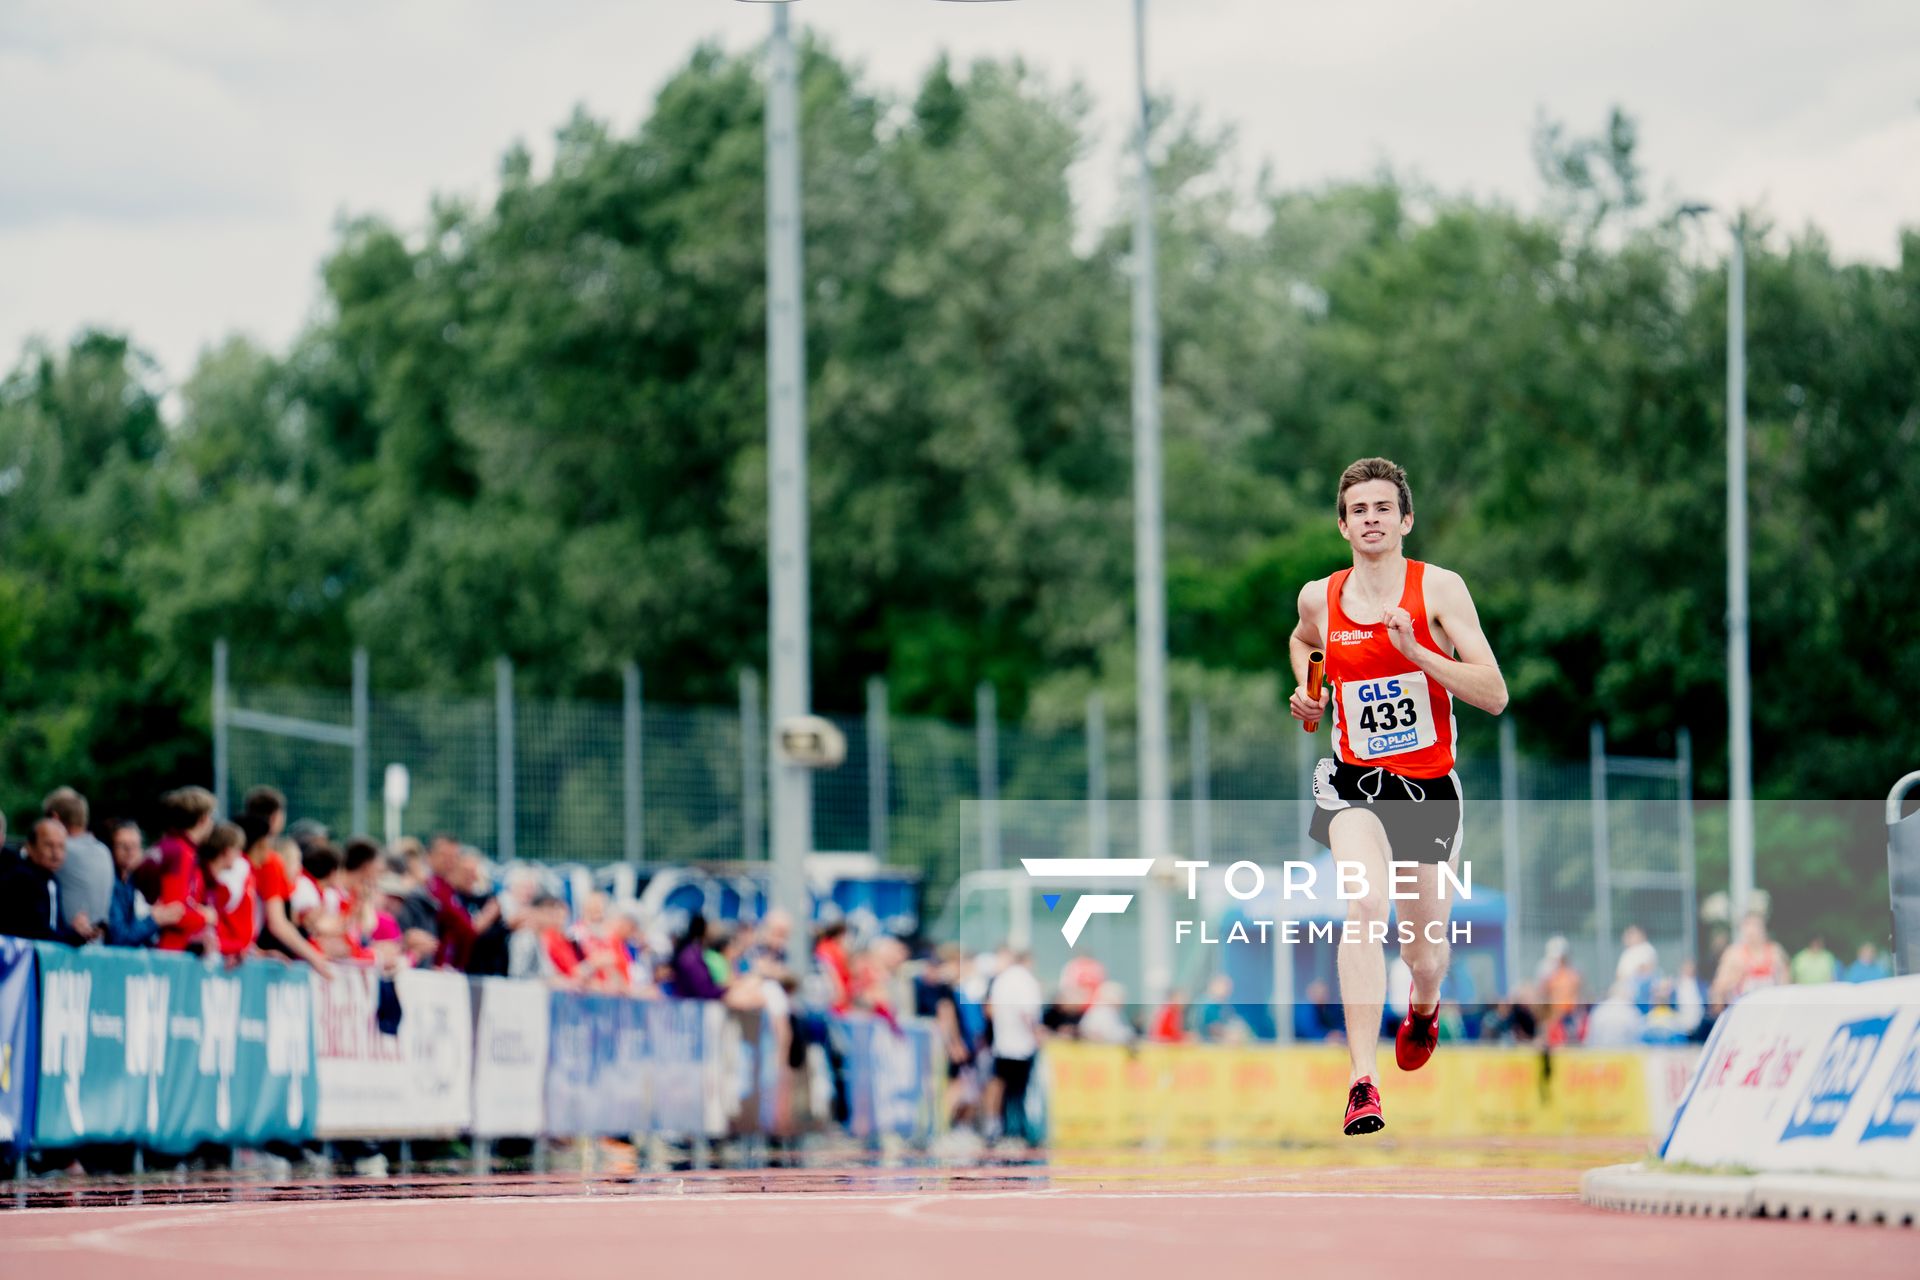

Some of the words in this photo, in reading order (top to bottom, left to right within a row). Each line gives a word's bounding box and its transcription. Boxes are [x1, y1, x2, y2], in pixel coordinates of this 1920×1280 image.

[1342, 630, 1373, 640] Brillux
[1360, 698, 1417, 733] 433
[1387, 732, 1416, 745] PLAN
